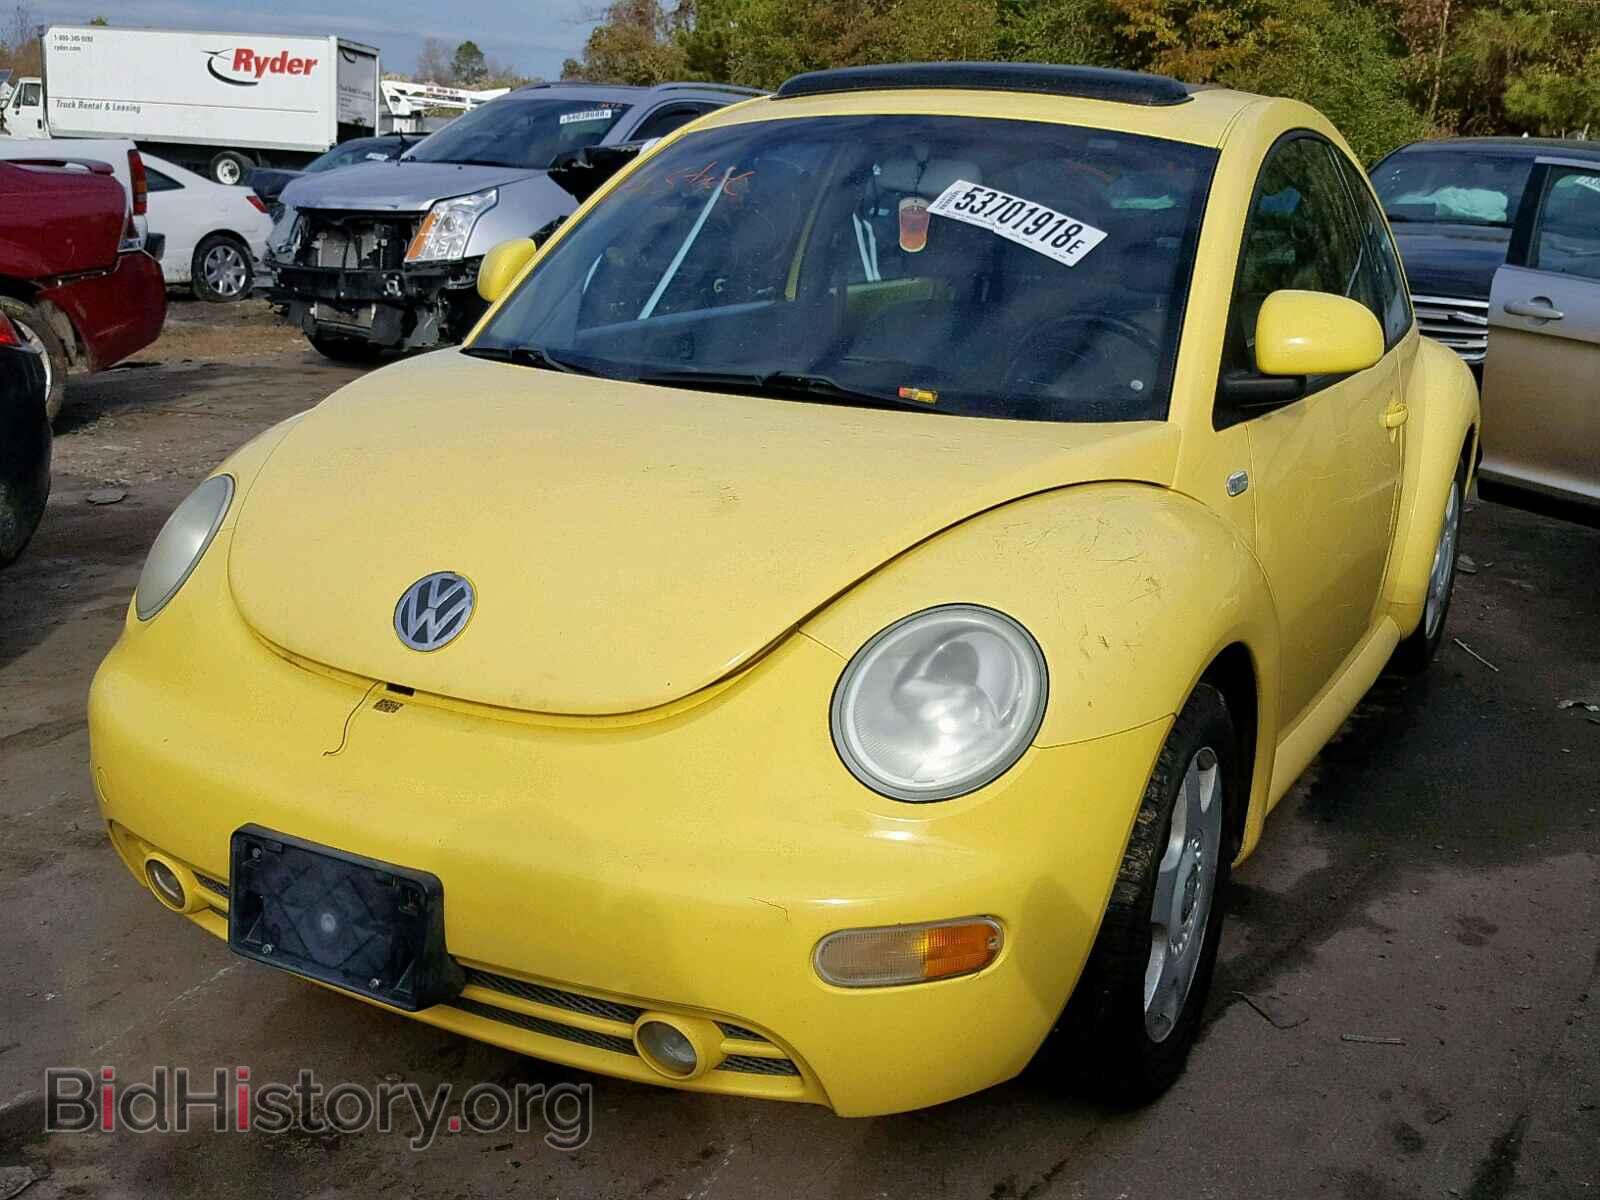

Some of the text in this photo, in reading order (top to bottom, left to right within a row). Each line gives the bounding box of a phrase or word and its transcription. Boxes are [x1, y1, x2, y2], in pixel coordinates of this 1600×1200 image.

[232, 48, 318, 78] Ryder
[56, 100, 142, 114] Truck Rental & Leasing
[955, 187, 1083, 248] 53701918
